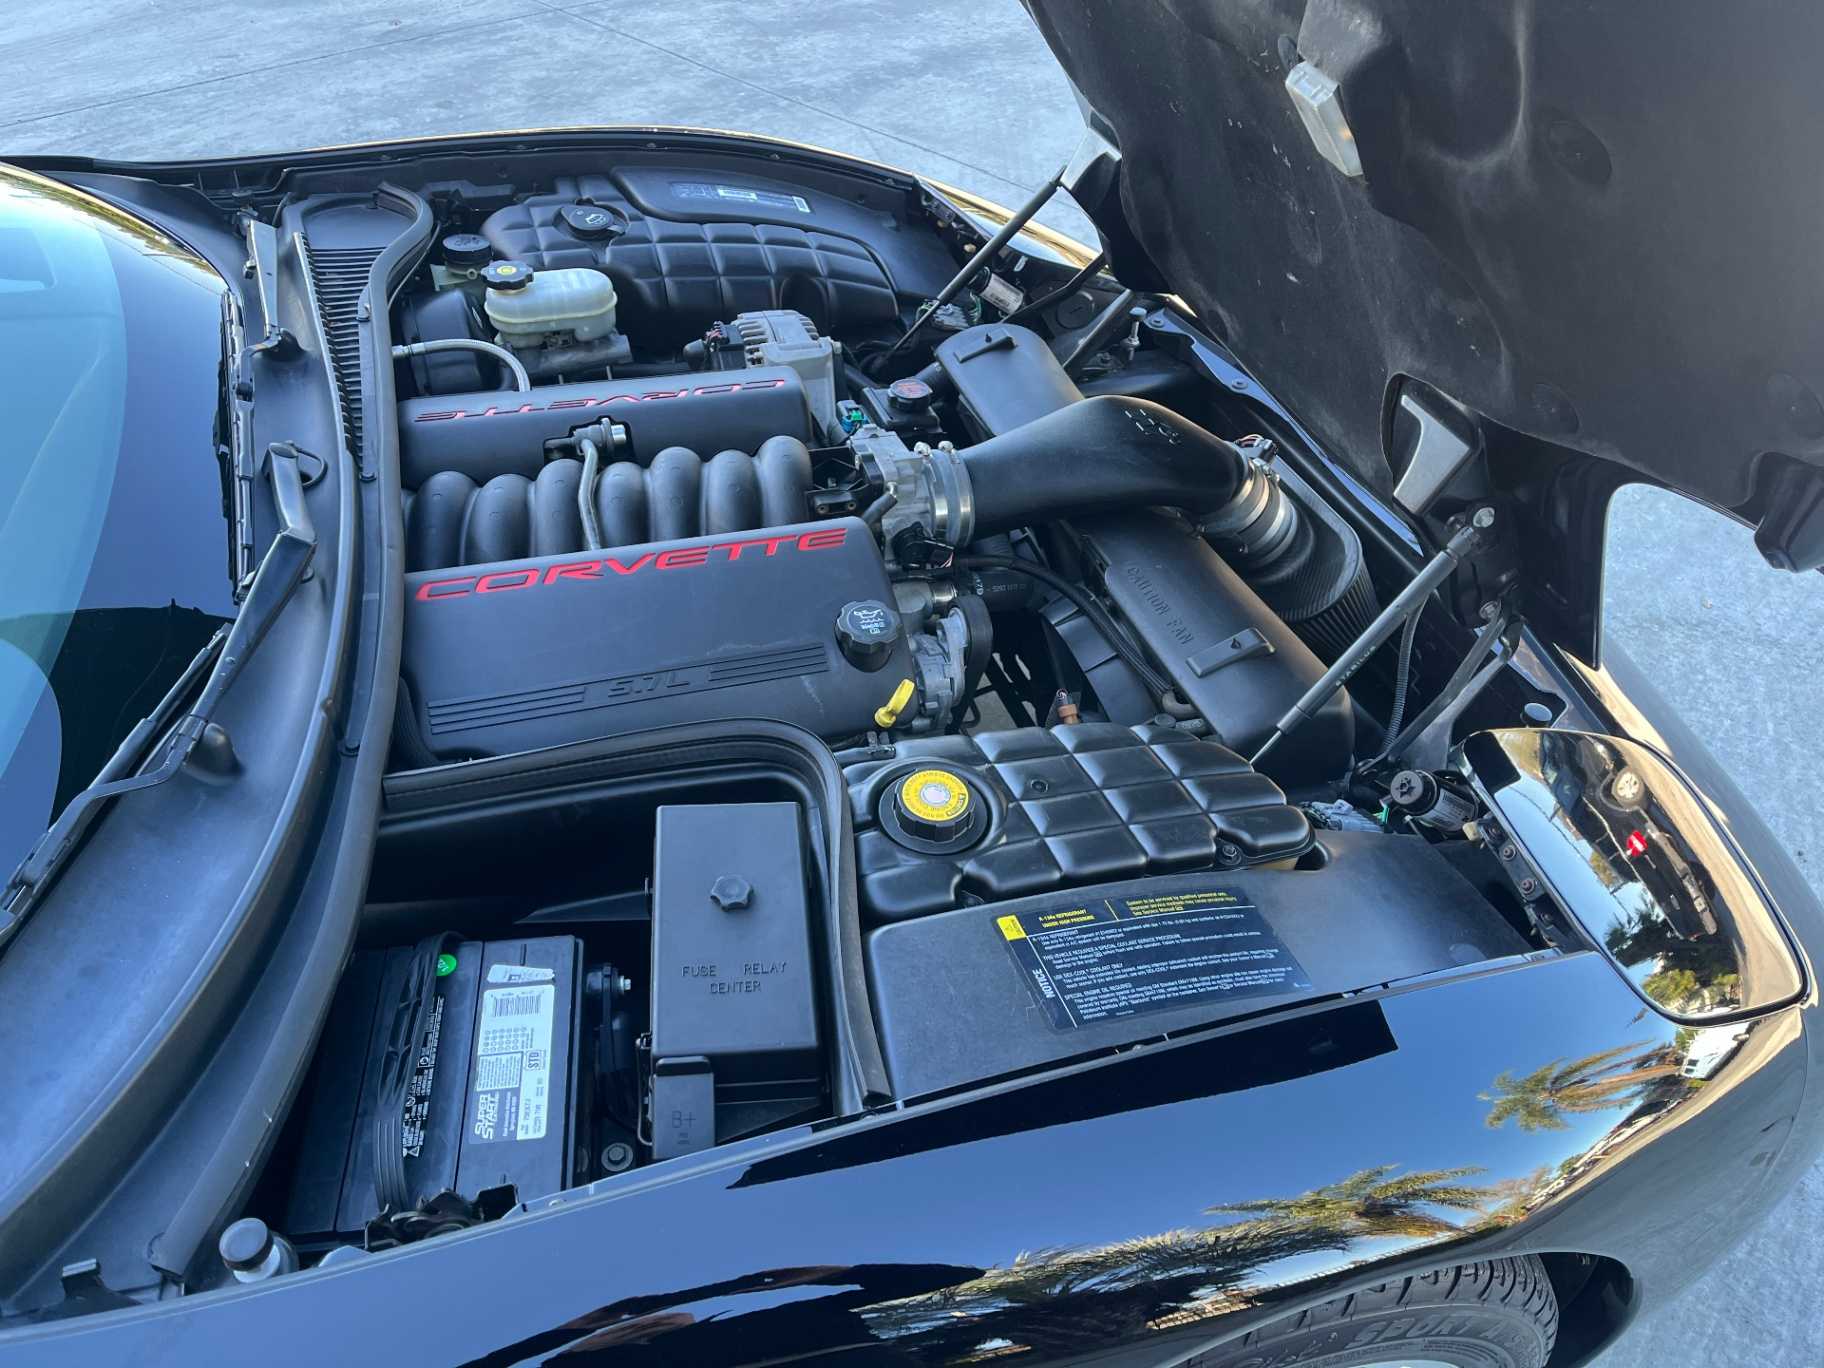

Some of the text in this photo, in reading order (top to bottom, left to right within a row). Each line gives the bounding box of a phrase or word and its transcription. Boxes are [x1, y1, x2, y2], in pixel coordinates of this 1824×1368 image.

[414, 379, 786, 423] CORVETTE
[415, 527, 848, 602] CORVETTE
[1127, 566, 1195, 645] CAUTION FAN
[607, 671, 691, 698] 5.7L
[681, 961, 787, 978] FUSE RELAY
[709, 980, 762, 994] CENTER
[1032, 968, 1056, 999] NOTICE
[475, 1094, 488, 1135] SUPER
[482, 1093, 495, 1140] START
[671, 1109, 697, 1129] B+
